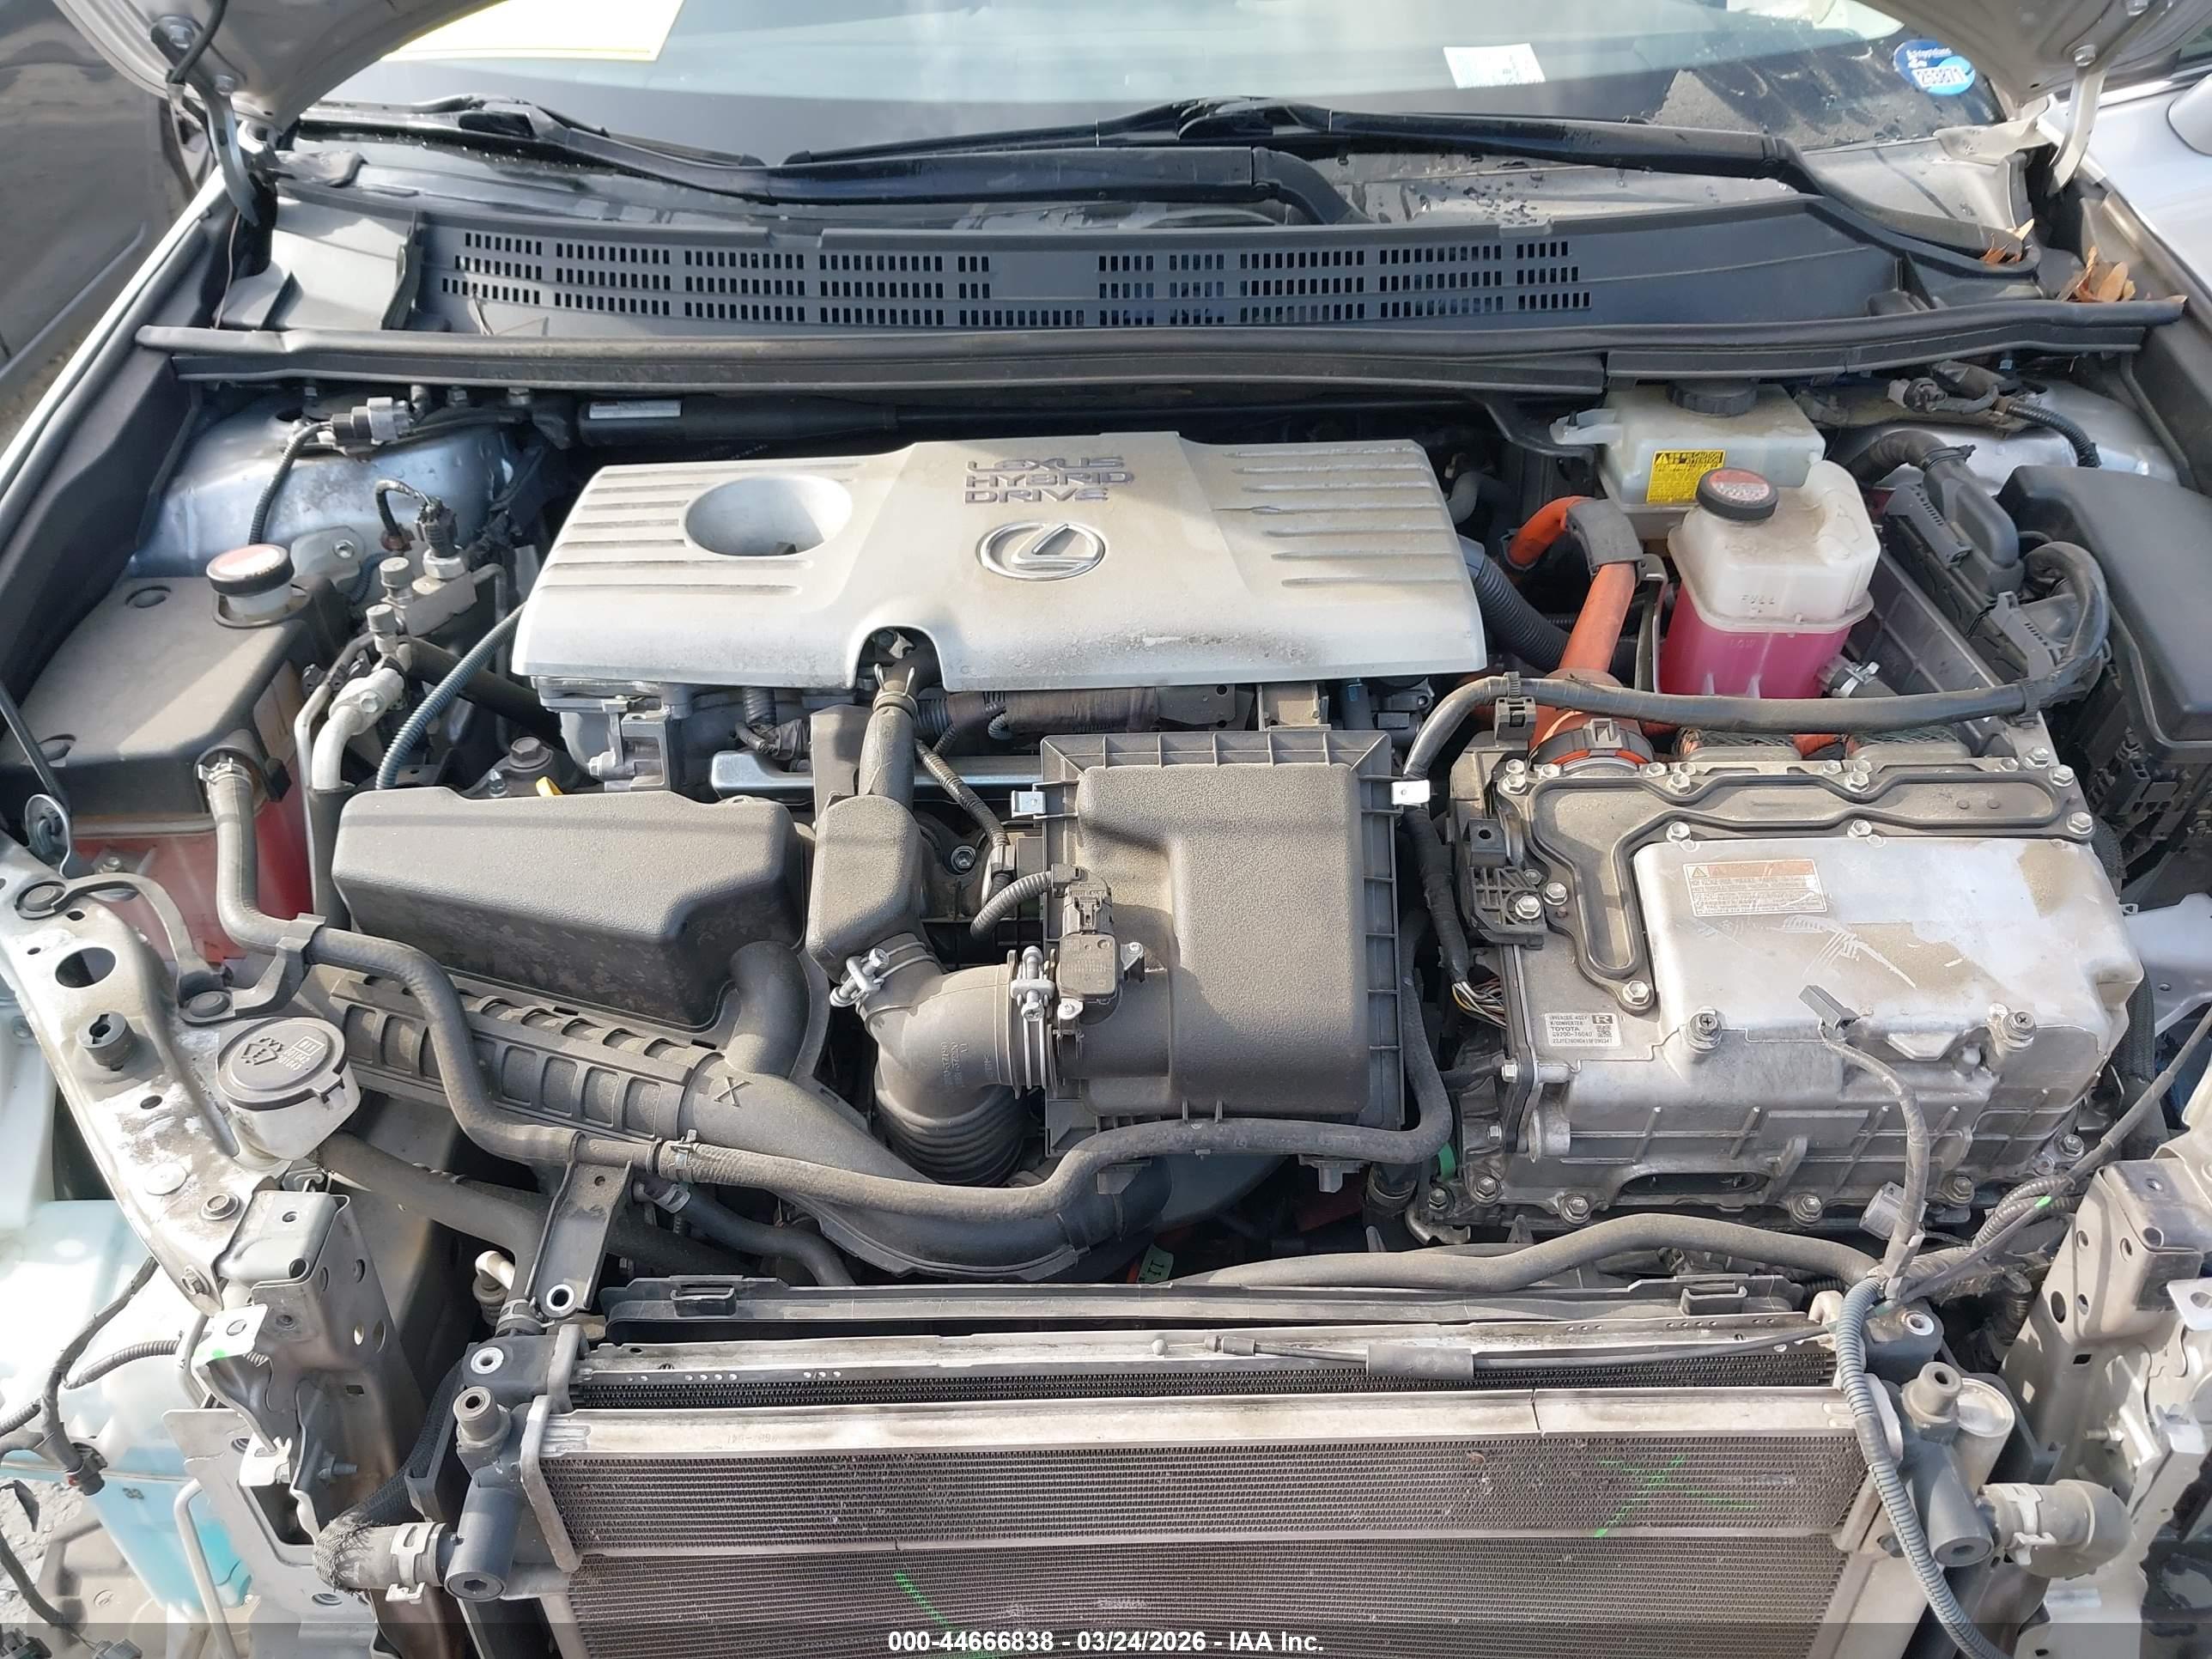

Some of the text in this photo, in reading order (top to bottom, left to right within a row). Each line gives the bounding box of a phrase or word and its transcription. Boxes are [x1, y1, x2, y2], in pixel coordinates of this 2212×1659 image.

[967, 456, 1125, 472] LEXUS
[965, 471, 1134, 488] HYBRID
[964, 487, 1109, 504] DRIVE
